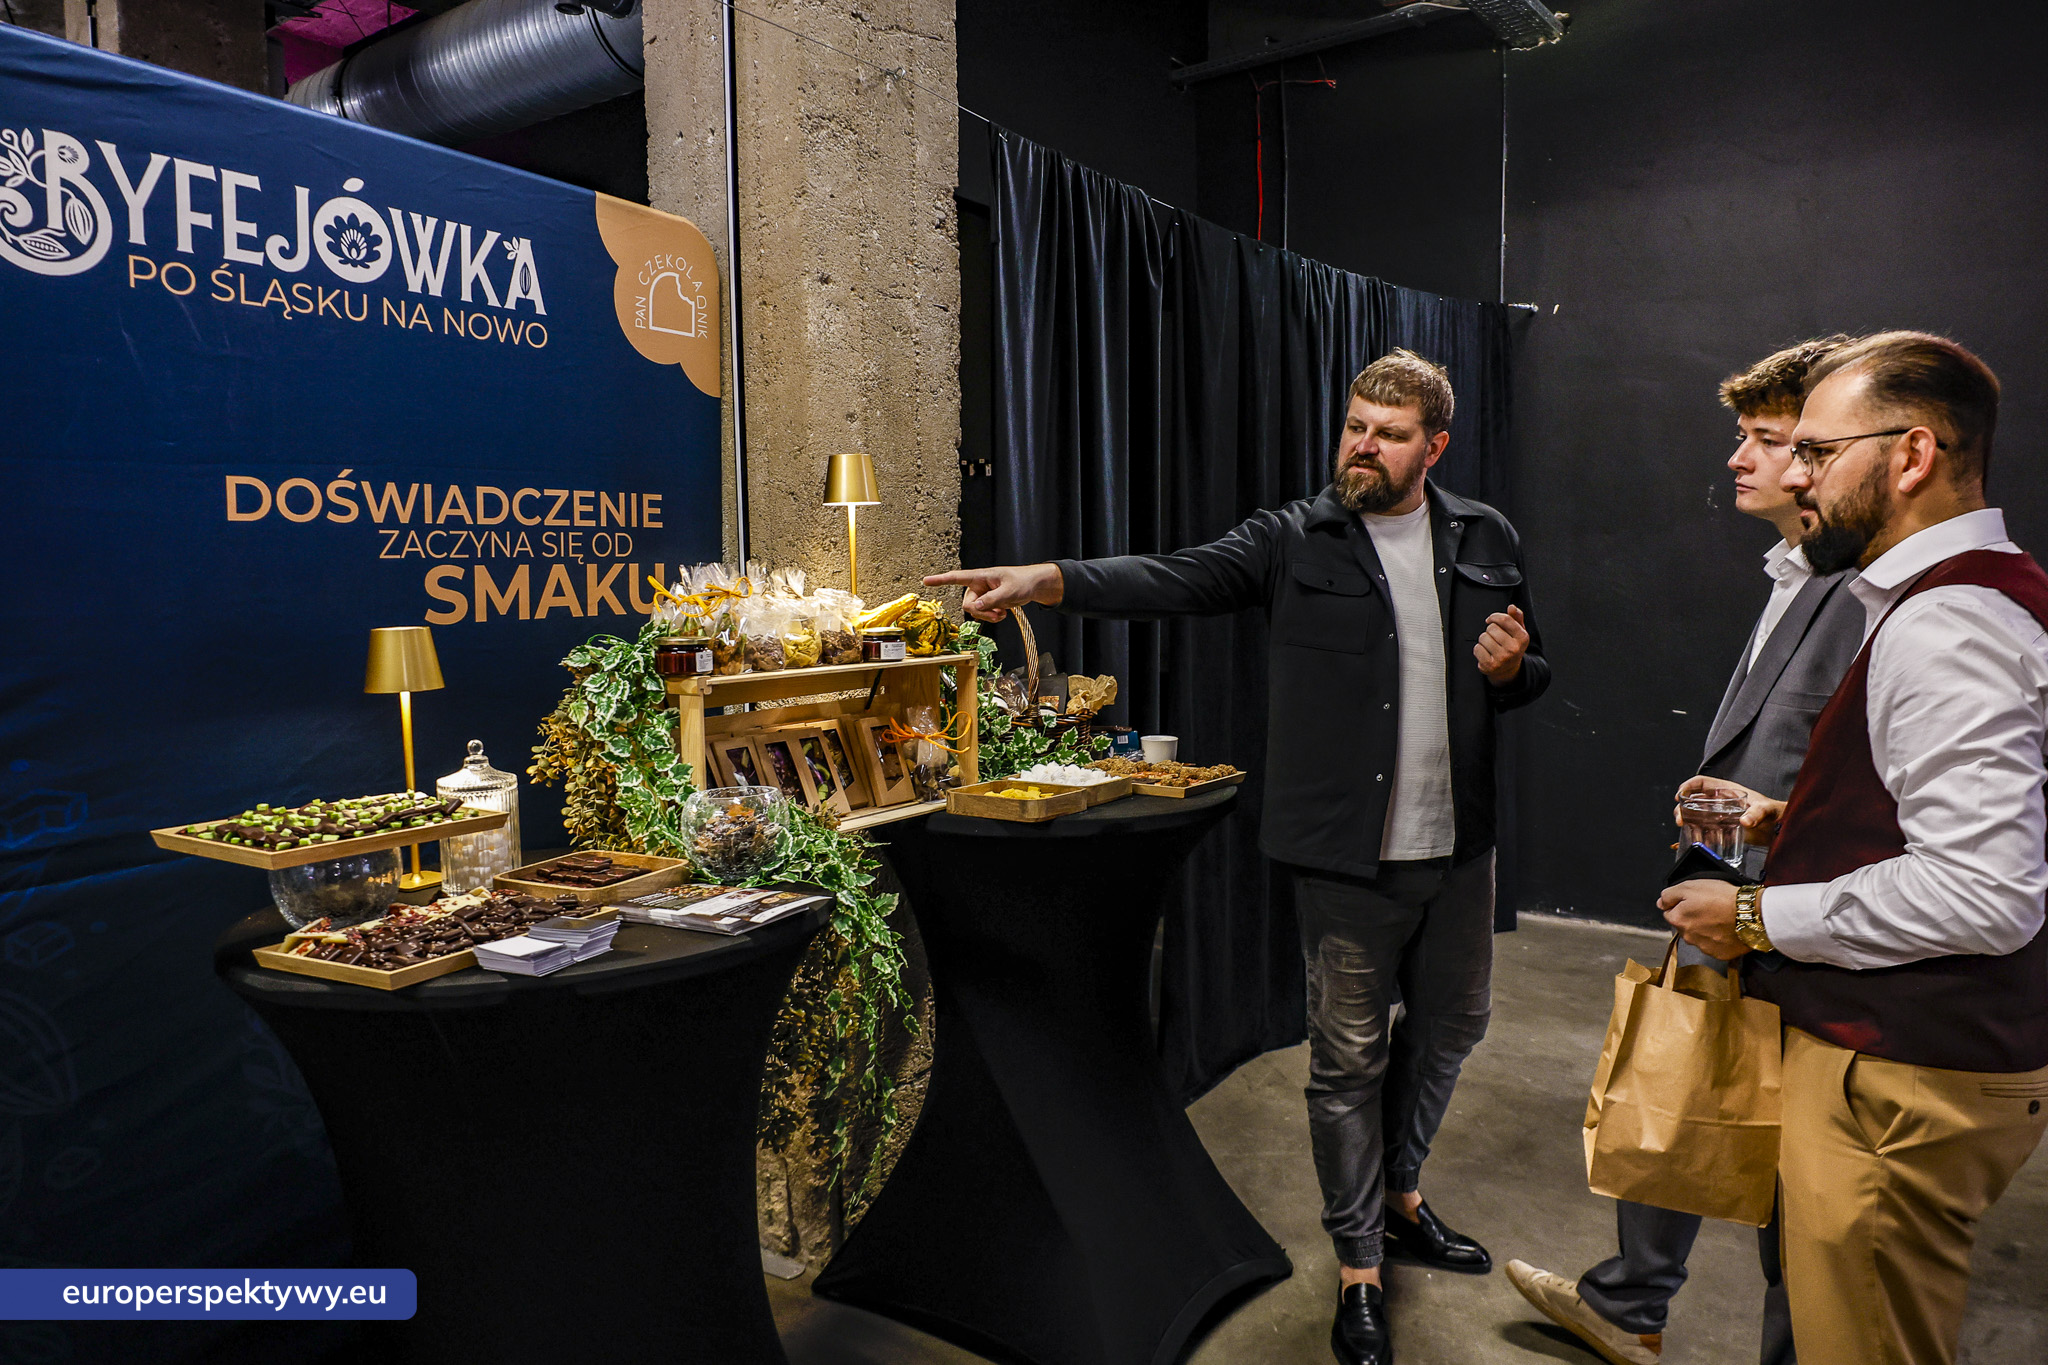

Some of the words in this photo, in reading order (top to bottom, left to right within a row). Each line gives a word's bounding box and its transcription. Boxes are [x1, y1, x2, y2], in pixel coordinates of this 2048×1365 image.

[0, 127, 548, 316] BYFEJÓWKA
[128, 254, 197, 296] PO
[210, 261, 369, 321] ŚLĄSKU
[382, 296, 434, 333] NA
[443, 307, 549, 349] NOWO
[635, 295, 647, 329] PAN
[638, 253, 708, 339] CZEKOLADNIK
[225, 468, 664, 529] DOŚWIADCZENIE
[378, 529, 535, 560] ZACZYNA
[541, 531, 585, 565] SIĘ
[591, 532, 633, 558] OD
[424, 562, 665, 626] SMAKU
